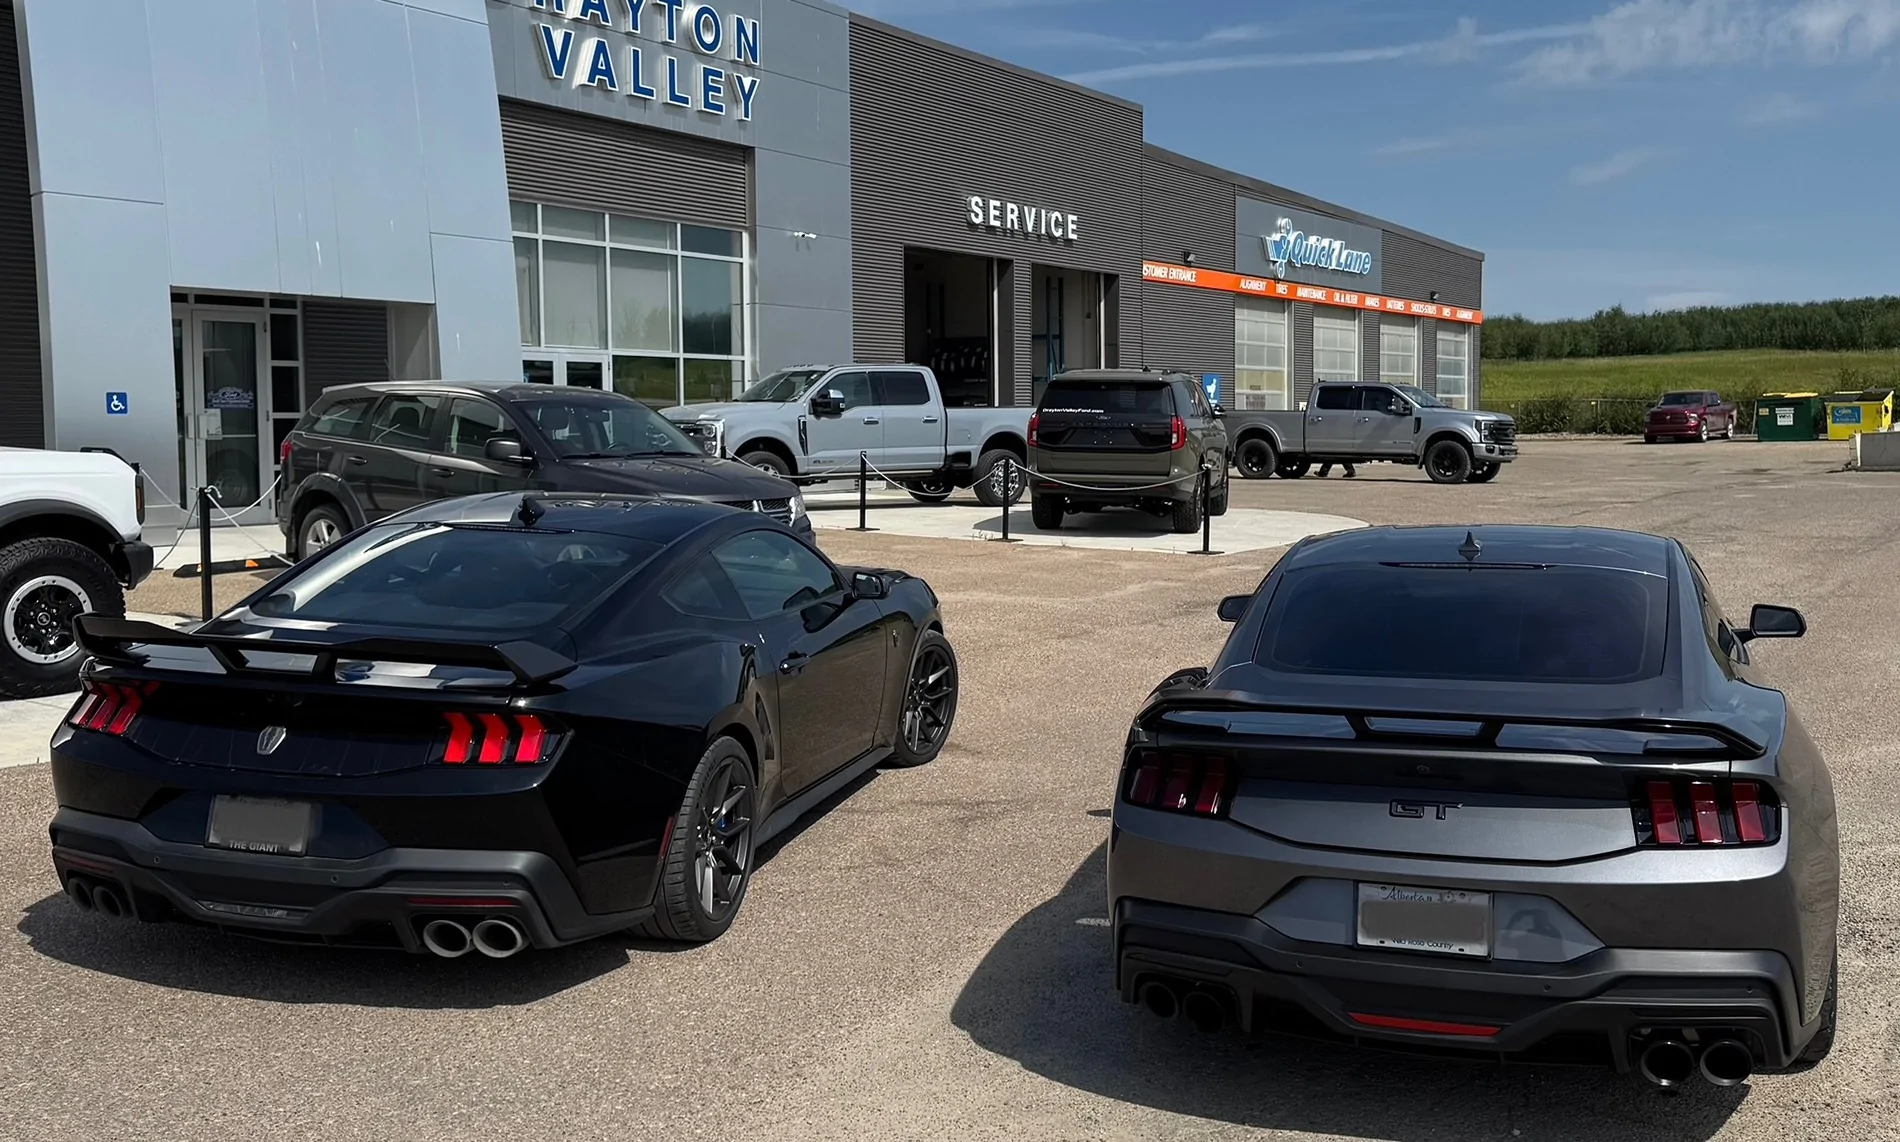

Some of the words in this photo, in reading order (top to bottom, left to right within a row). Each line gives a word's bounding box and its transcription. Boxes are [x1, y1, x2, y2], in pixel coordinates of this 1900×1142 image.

[530, 0, 760, 66] AYTON
[538, 23, 760, 121] VALLEY
[968, 195, 1078, 240] SERVICE
[1142, 263, 1168, 279] STOMER
[1168, 268, 1197, 283] ENTRANCE
[1239, 278, 1267, 292] ALIGNMENT
[1275, 282, 1289, 295] TIRES
[1389, 799, 1464, 820] GT
[229, 840, 247, 850] THE
[248, 842, 279, 853] GIANT
